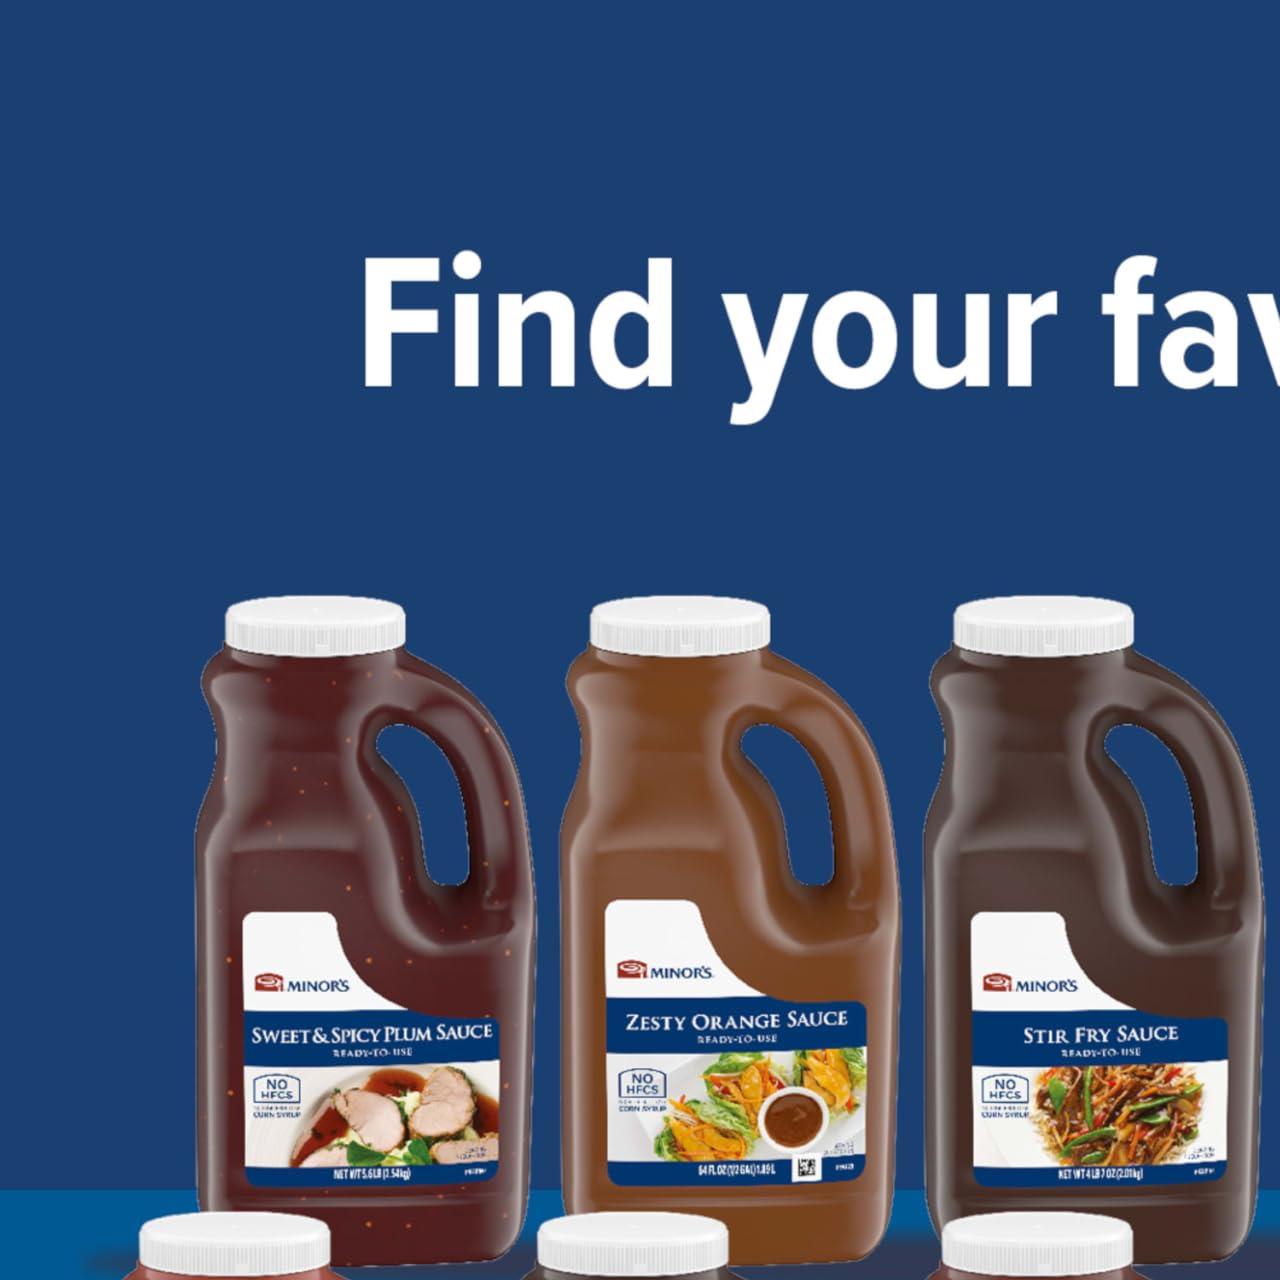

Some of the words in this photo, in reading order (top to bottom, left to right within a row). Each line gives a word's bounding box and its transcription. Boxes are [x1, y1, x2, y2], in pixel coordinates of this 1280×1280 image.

[650, 966, 712, 979] MINOR'S
[287, 979, 349, 993] MINOR'S
[1016, 979, 1078, 993] MINOR'S
[626, 1013, 686, 1031] ZESTY
[692, 1013, 780, 1030] ORANGE
[787, 1011, 848, 1027] SAUCE
[252, 1027, 311, 1044] SWEET
[312, 1027, 330, 1043] &
[331, 1027, 381, 1043] SPICY
[384, 1026, 432, 1042] PLUM
[437, 1024, 493, 1040] SAUCE
[1024, 1027, 1069, 1044] STIR
[1075, 1026, 1111, 1043] FRY
[1117, 1025, 1179, 1042] SAUCE
[267, 1079, 287, 1090] NO
[632, 1073, 653, 1084] NO
[995, 1079, 1015, 1090] NO
[261, 1091, 293, 1100] HFCS
[627, 1085, 659, 1094] HFCS
[990, 1091, 1021, 1100] HFCS
